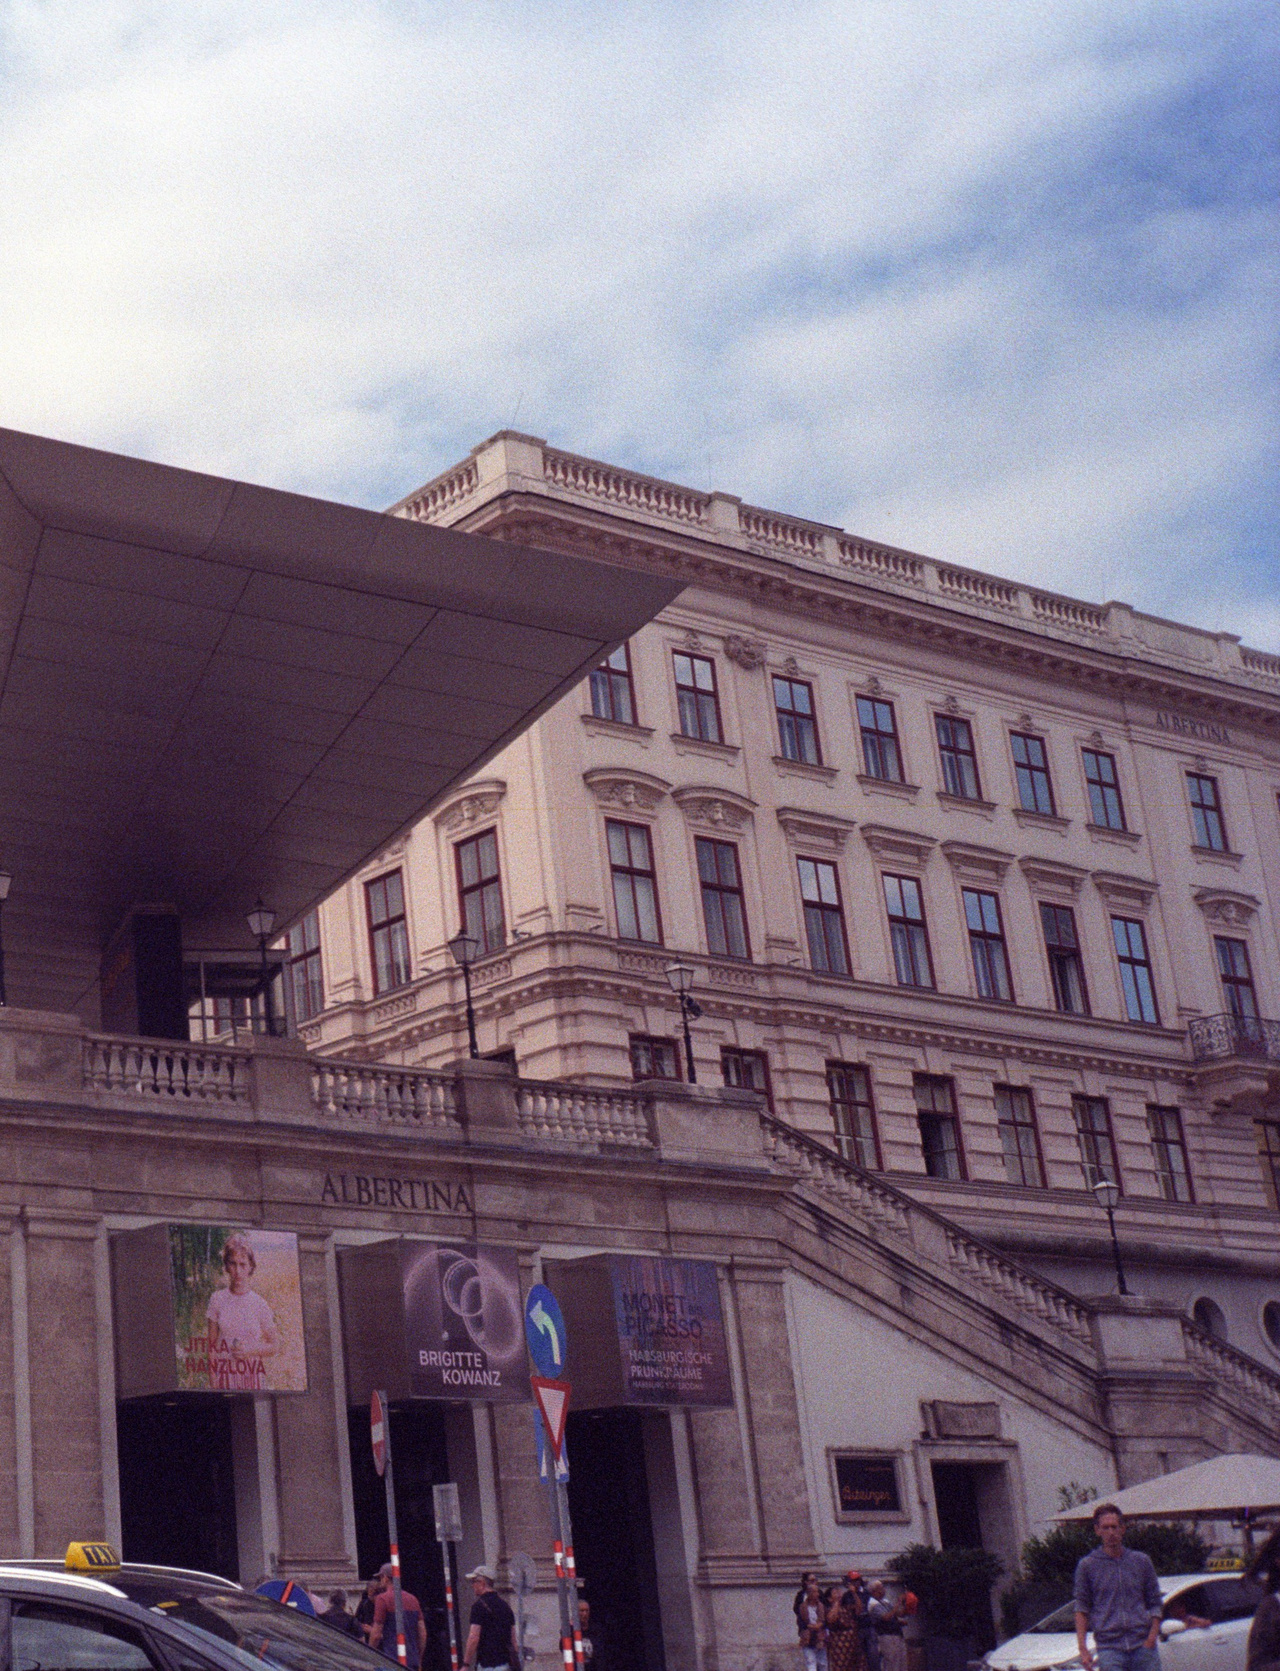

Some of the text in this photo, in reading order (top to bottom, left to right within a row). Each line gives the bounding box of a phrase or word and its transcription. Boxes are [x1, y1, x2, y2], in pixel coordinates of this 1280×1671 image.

[1156, 711, 1231, 744] ALBERTINA
[321, 1173, 473, 1213] ALBERTINA
[622, 1292, 686, 1315] MONET
[625, 1316, 703, 1339] PICASSO
[184, 1337, 230, 1353] JITKA
[419, 1349, 482, 1368] BRIGITTE
[441, 1368, 501, 1387] KOWANZ
